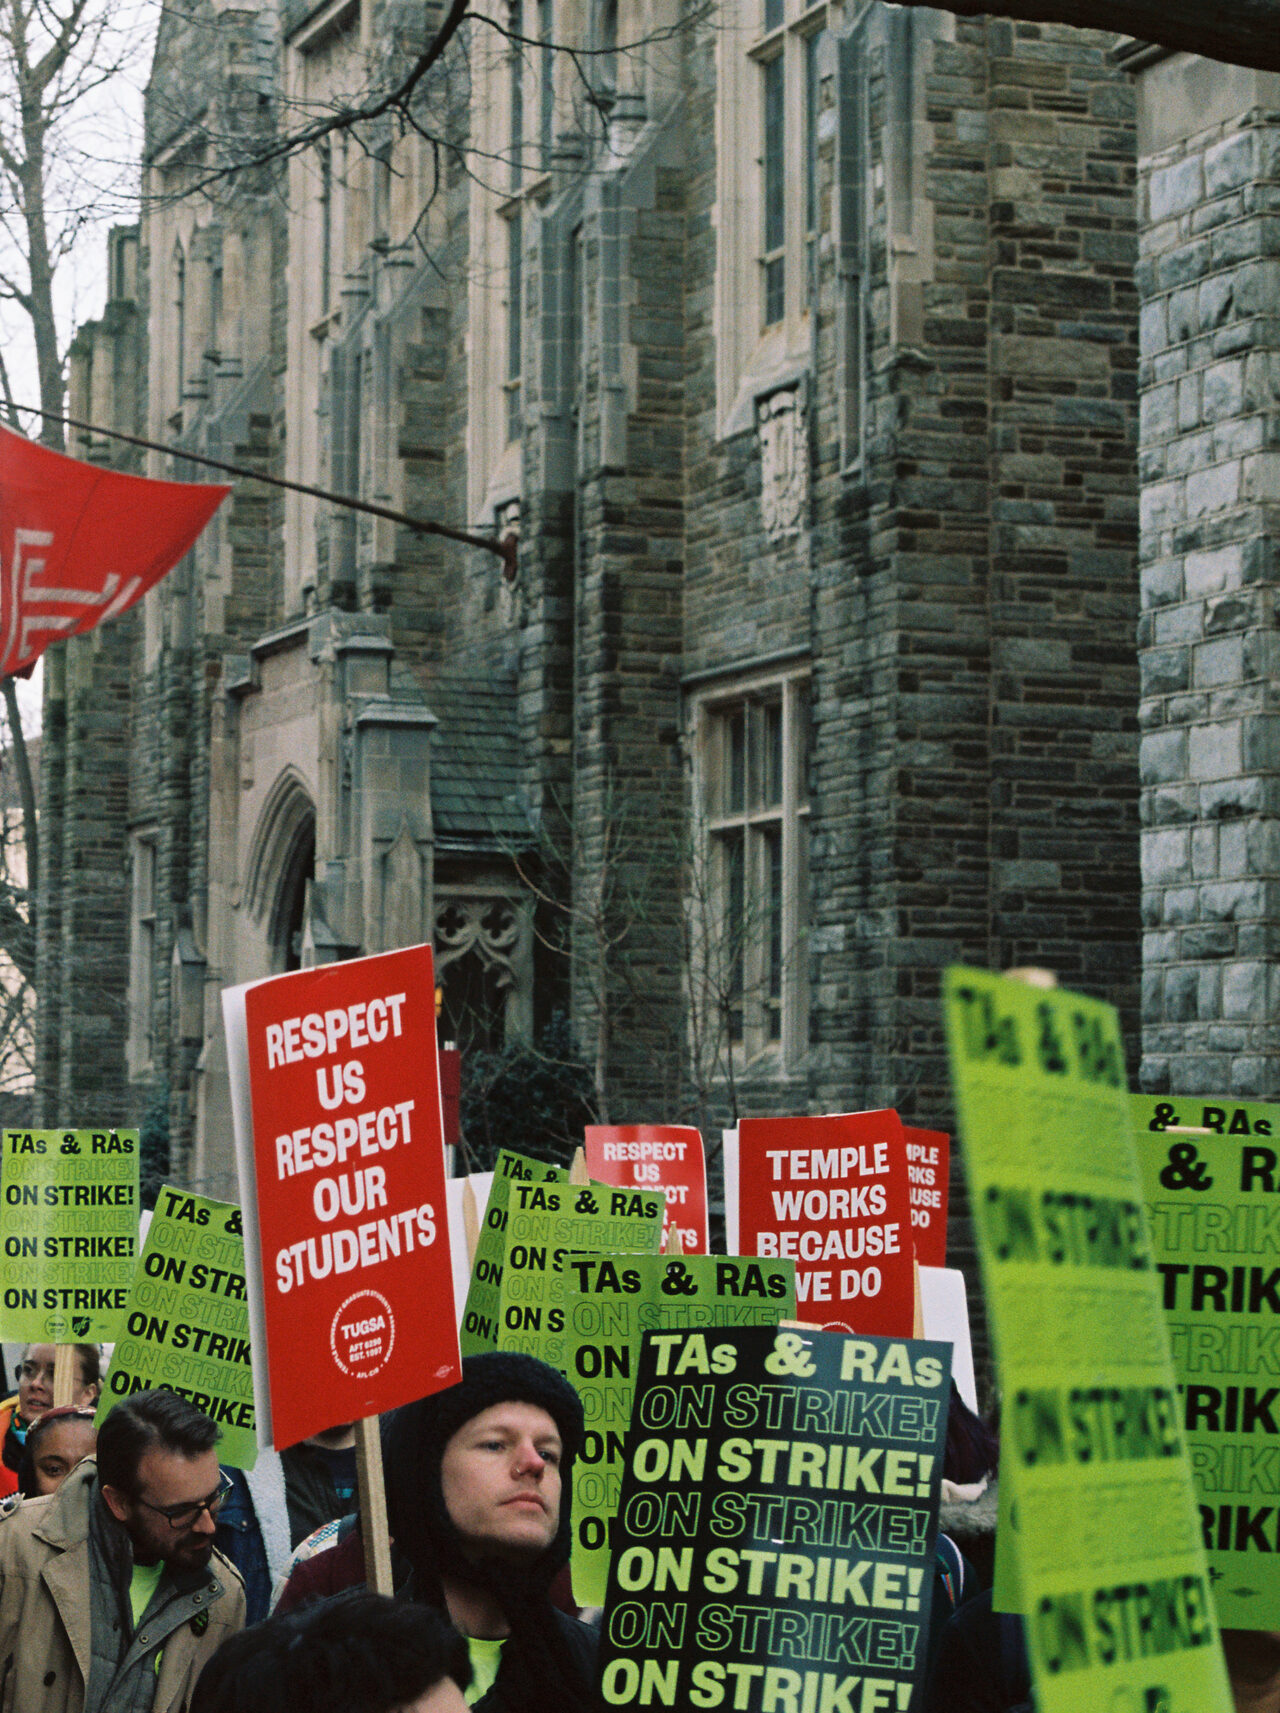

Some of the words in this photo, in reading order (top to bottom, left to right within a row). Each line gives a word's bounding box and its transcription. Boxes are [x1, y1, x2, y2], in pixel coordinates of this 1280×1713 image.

[266, 992, 406, 1070] RESPECT
[316, 1060, 366, 1110] US
[1149, 1103, 1180, 1132] &
[1202, 1106, 1272, 1135] RAs
[8, 1134, 47, 1154] TAs
[60, 1134, 81, 1154] &
[92, 1134, 134, 1154] RAs
[276, 1100, 415, 1181] RESPECT
[603, 1142, 687, 1160] RESPECT
[634, 1164, 660, 1182] US
[766, 1142, 890, 1180] TEMPLE
[1159, 1143, 1213, 1191] &
[6, 1185, 38, 1206] ON
[43, 1185, 134, 1206] STRIKE!
[313, 1165, 387, 1223] OUR
[517, 1186, 560, 1211] TAs
[575, 1190, 599, 1214] &
[611, 1193, 658, 1218] RAs
[771, 1184, 887, 1221] WORKS
[165, 1193, 211, 1225] TAs
[224, 1209, 243, 1236] &
[5, 1237, 37, 1258] ON
[43, 1237, 134, 1258] STRIKE!
[276, 1203, 437, 1294] STUDENTS
[513, 1215, 550, 1243] ON
[554, 1218, 654, 1249] STRIKE!
[757, 1223, 900, 1262] BECAUSE
[144, 1253, 186, 1284] ON
[510, 1246, 546, 1270] ON
[571, 1261, 641, 1294] TAs
[662, 1261, 698, 1296] &
[716, 1263, 786, 1298] RAs
[840, 1266, 881, 1300] DO
[4, 1289, 37, 1309] ON
[43, 1289, 131, 1309] STRIKE
[127, 1312, 169, 1344] ON
[341, 1315, 385, 1339] TUGSA
[505, 1307, 541, 1332] ON
[572, 1302, 629, 1336] ON
[349, 1342, 363, 1353] AFT
[575, 1345, 629, 1378] ON
[650, 1334, 737, 1376] TAs
[764, 1333, 817, 1378] &
[841, 1339, 944, 1388] RAs
[111, 1371, 151, 1395] ON
[640, 1384, 715, 1430] ON
[723, 1383, 941, 1442] STRIKE!
[633, 1438, 708, 1483] ON
[717, 1438, 934, 1498] STRIKE!
[624, 1492, 701, 1537] ON
[710, 1492, 930, 1555] STRIKE!
[617, 1547, 693, 1592] ON
[703, 1547, 924, 1612] STRIKE!
[608, 1601, 686, 1649] ON
[696, 1603, 919, 1670] STRIKE!
[601, 1658, 679, 1706] ON
[689, 1660, 913, 1713] STRIKE!
